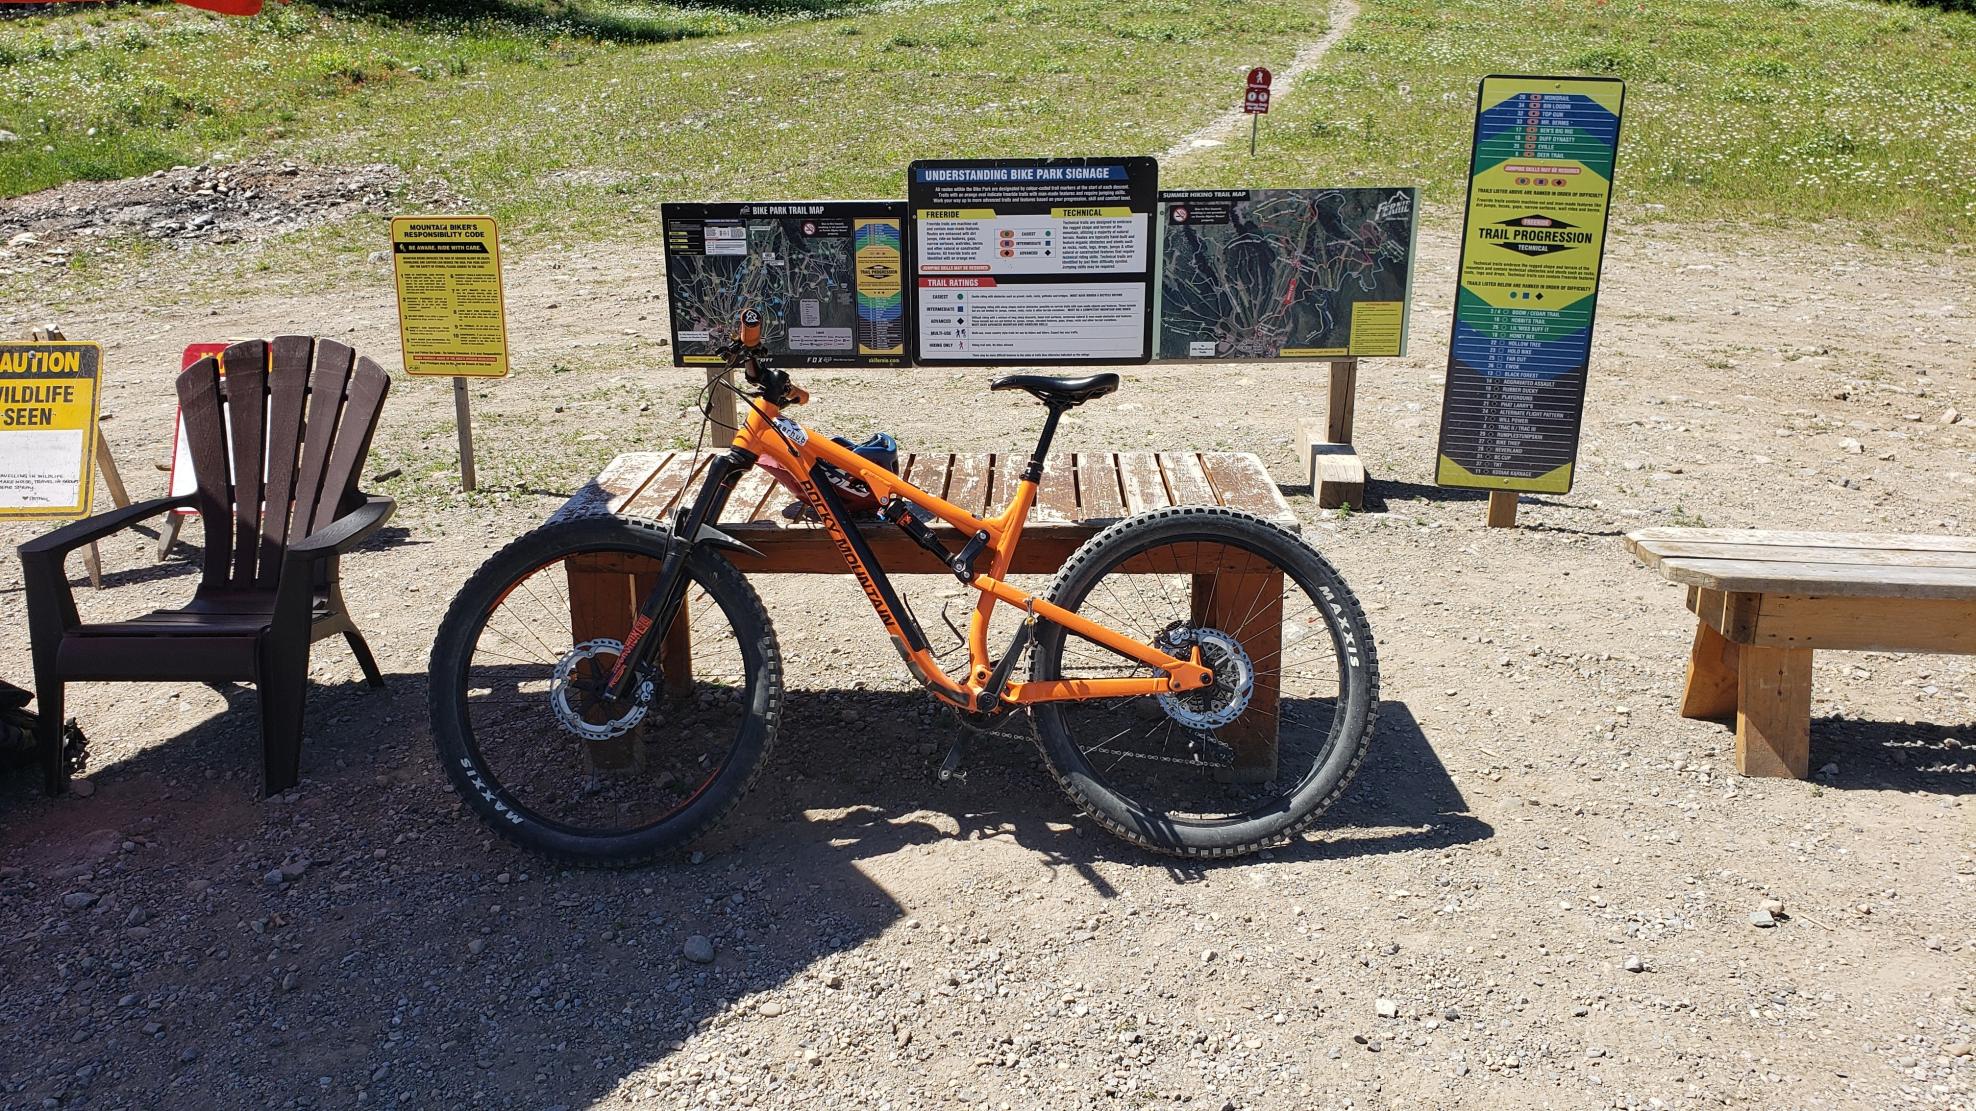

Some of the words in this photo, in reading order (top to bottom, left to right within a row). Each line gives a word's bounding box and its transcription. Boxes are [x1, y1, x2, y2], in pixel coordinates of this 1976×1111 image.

[925, 170, 1007, 180] UNDERSTANDING
[1011, 168, 1034, 180] BIKE
[1037, 168, 1063, 179] PARK
[1066, 168, 1109, 179] SIGNAGE
[752, 206, 768, 214] BIKE
[770, 206, 787, 214] PARK
[789, 206, 808, 214] TRAIL
[809, 206, 824, 214] MAP
[1479, 228, 1509, 240] TRAIL
[1513, 229, 1592, 244] PROGRESSION
[0, 351, 80, 373] AUTION
[3, 407, 52, 426] SEEN
[801, 481, 840, 534] ROCKY
[836, 539, 896, 626] MOUNTAIN
[1318, 586, 1360, 667] MAXXIS
[460, 758, 524, 824] MAXXIS
